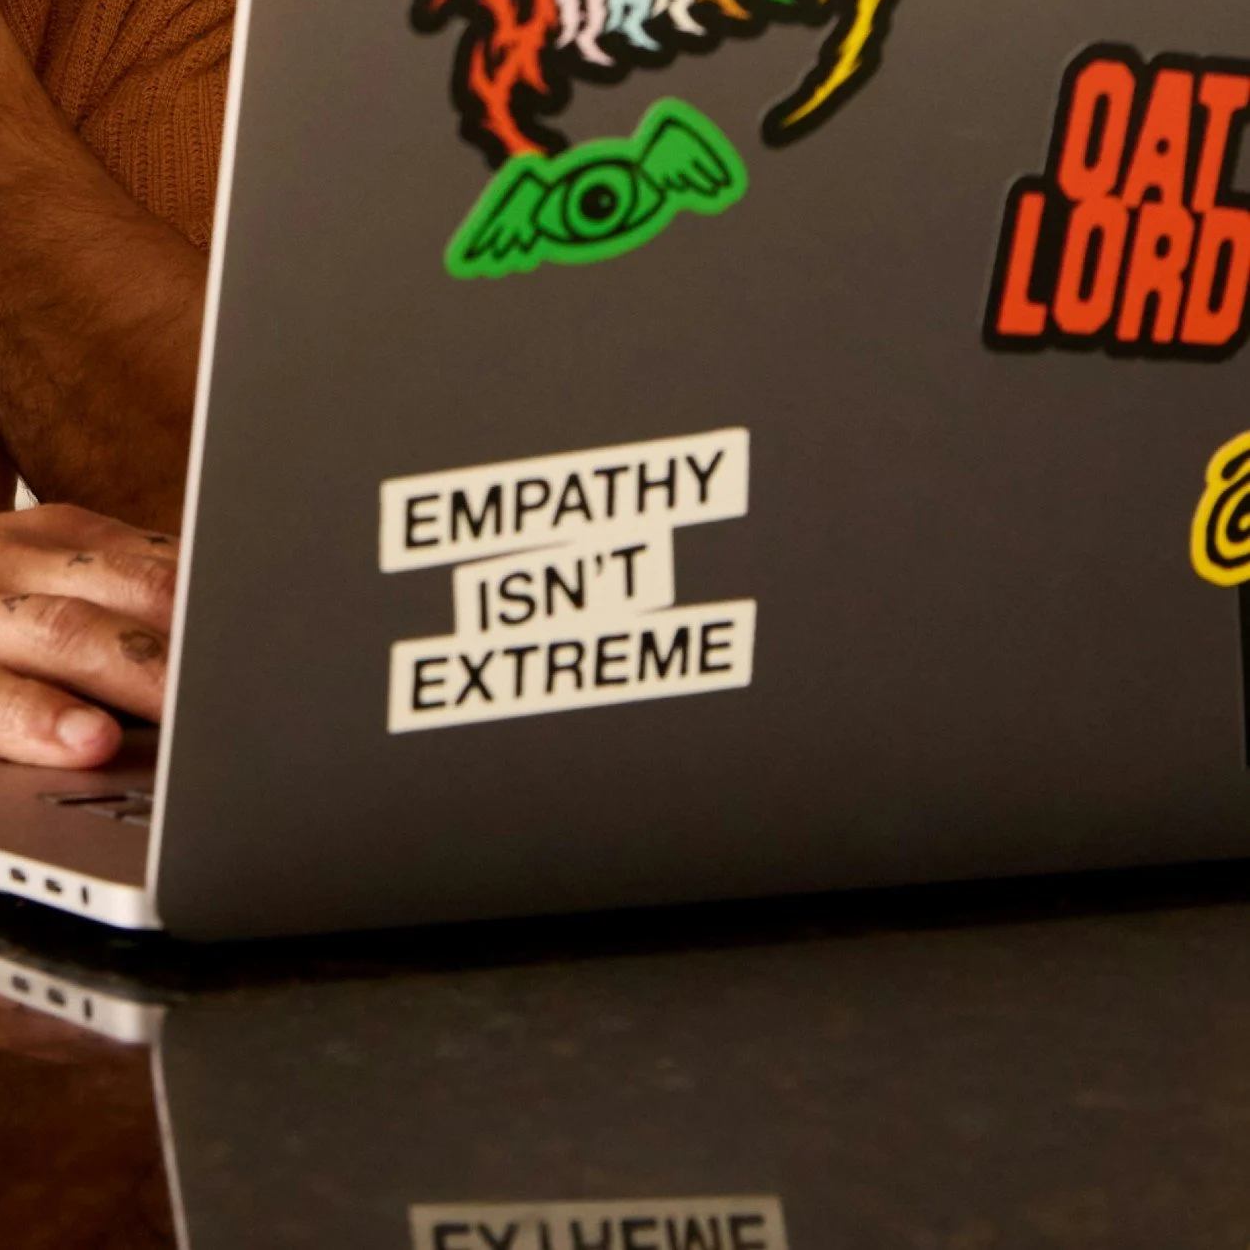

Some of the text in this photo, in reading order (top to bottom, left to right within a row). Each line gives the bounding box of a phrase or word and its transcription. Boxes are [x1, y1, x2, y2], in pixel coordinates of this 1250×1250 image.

[1056, 58, 1250, 214] OAT
[994, 192, 1250, 347] LORD
[403, 449, 725, 549] EMPATHY
[479, 543, 648, 633] ISN'T
[410, 620, 735, 713] EXTREME
